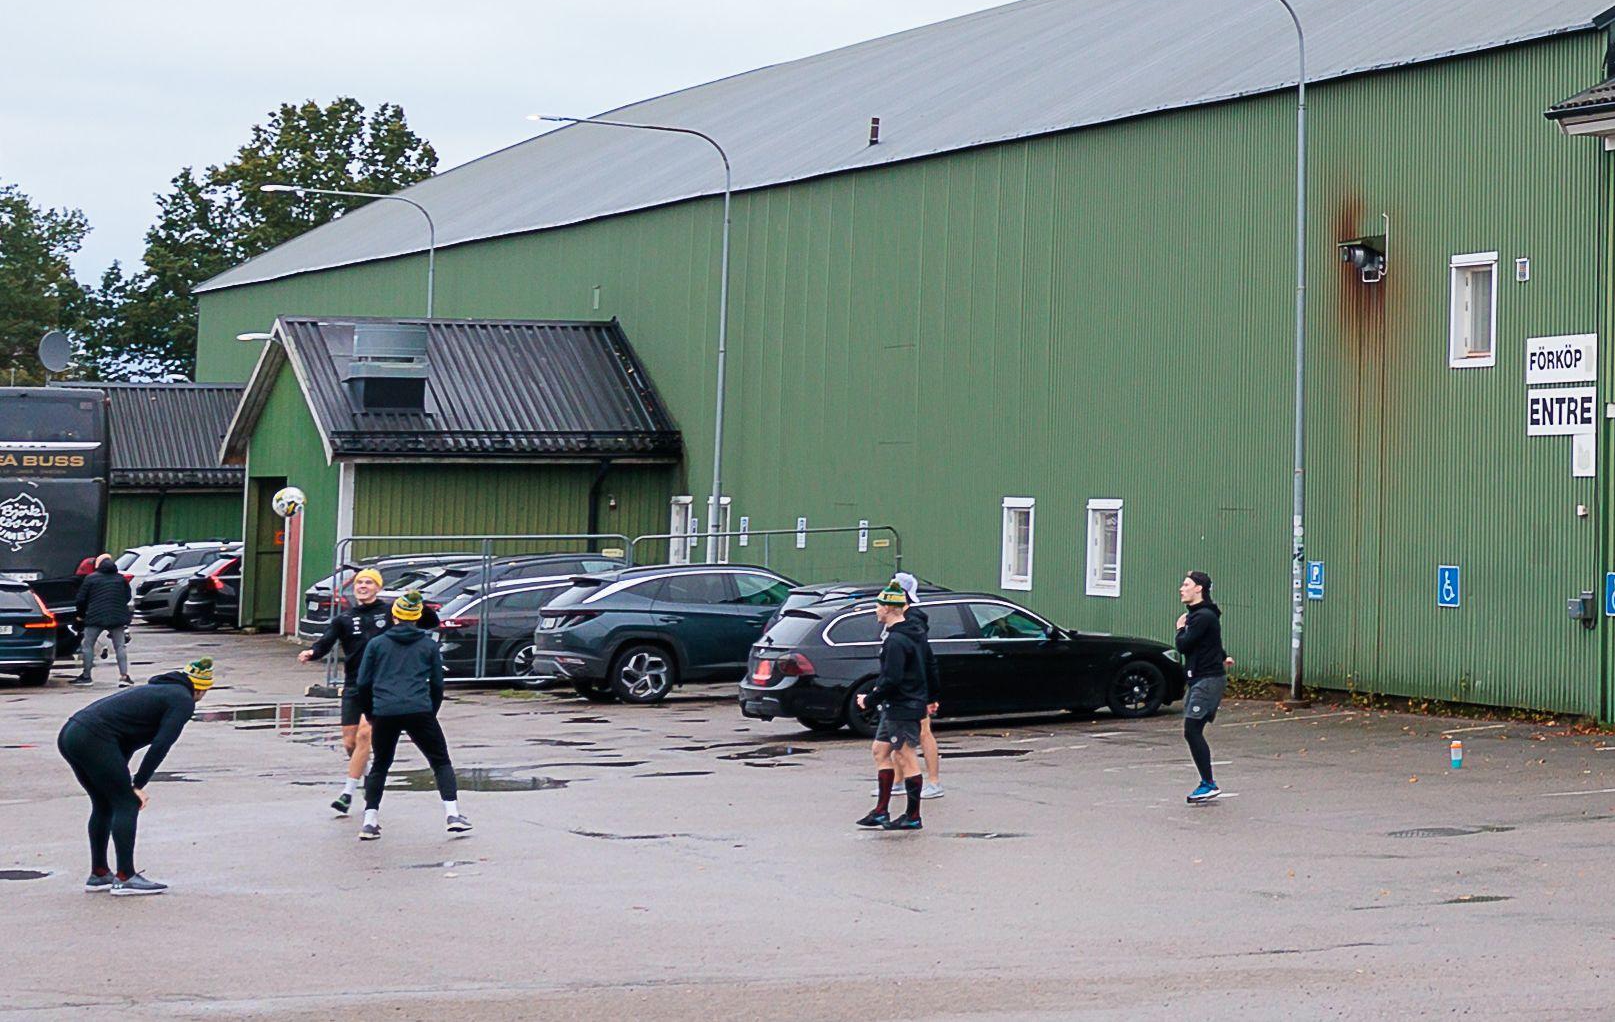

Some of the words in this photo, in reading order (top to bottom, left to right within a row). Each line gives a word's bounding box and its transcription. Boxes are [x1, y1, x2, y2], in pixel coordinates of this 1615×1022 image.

[1530, 344, 1582, 370] FÖRKÖP
[1530, 396, 1593, 425] ENTRE
[23, 455, 85, 466] BUSS
